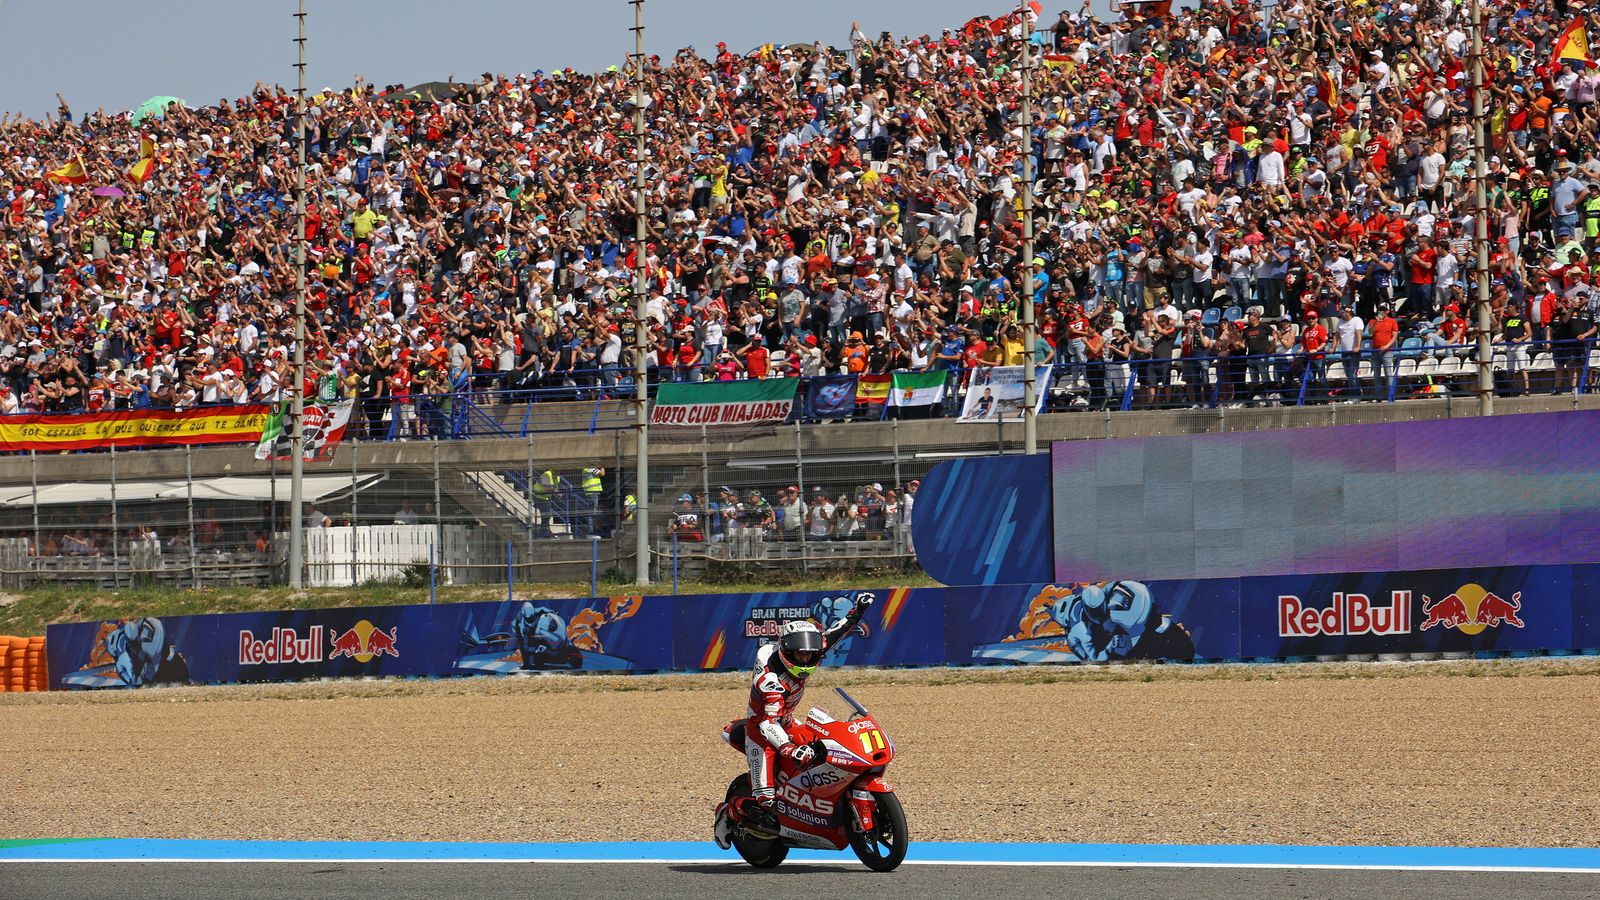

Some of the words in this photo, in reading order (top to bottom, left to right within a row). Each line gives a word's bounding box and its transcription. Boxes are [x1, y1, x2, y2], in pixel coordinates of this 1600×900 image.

[652, 406, 686, 424] MOTO
[688, 404, 721, 424] CLUB
[720, 401, 790, 423] MIAJADAS
[115, 424, 133, 434] QUE
[140, 423, 182, 432] QUIERES
[215, 420, 228, 429] TE
[751, 608, 776, 619] GRAN
[778, 607, 811, 619] PREMIO
[1278, 592, 1344, 637] Red
[1346, 590, 1412, 635] Bull
[239, 627, 280, 665] Red
[280, 625, 323, 664] Bull
[859, 730, 886, 754] 11
[787, 806, 828, 826] solunion
